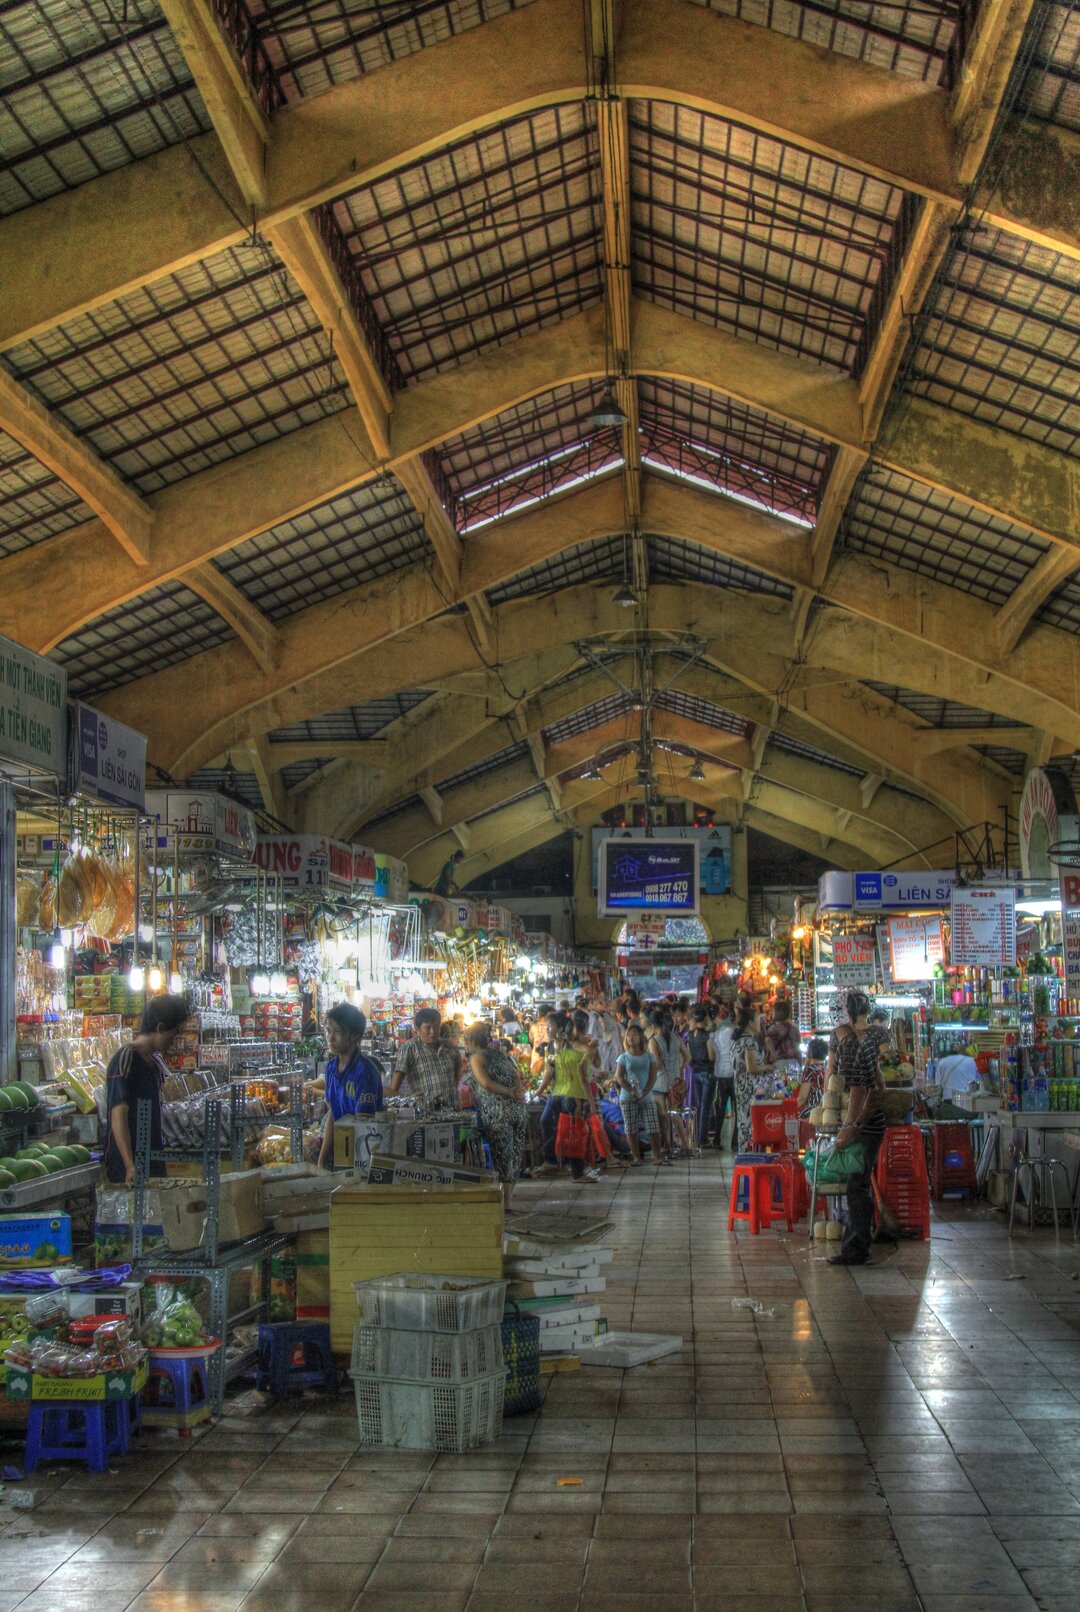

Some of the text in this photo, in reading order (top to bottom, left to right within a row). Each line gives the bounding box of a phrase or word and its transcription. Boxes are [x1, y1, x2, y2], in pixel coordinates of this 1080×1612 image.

[660, 883, 672, 892] 277
[673, 881, 688, 892] 470
[898, 885, 931, 901] LIÊN
[355, 1160, 368, 1168] BIG
[395, 1168, 433, 1182] CRUNCH
[39, 1387, 104, 1397] FRESH FRUIT
